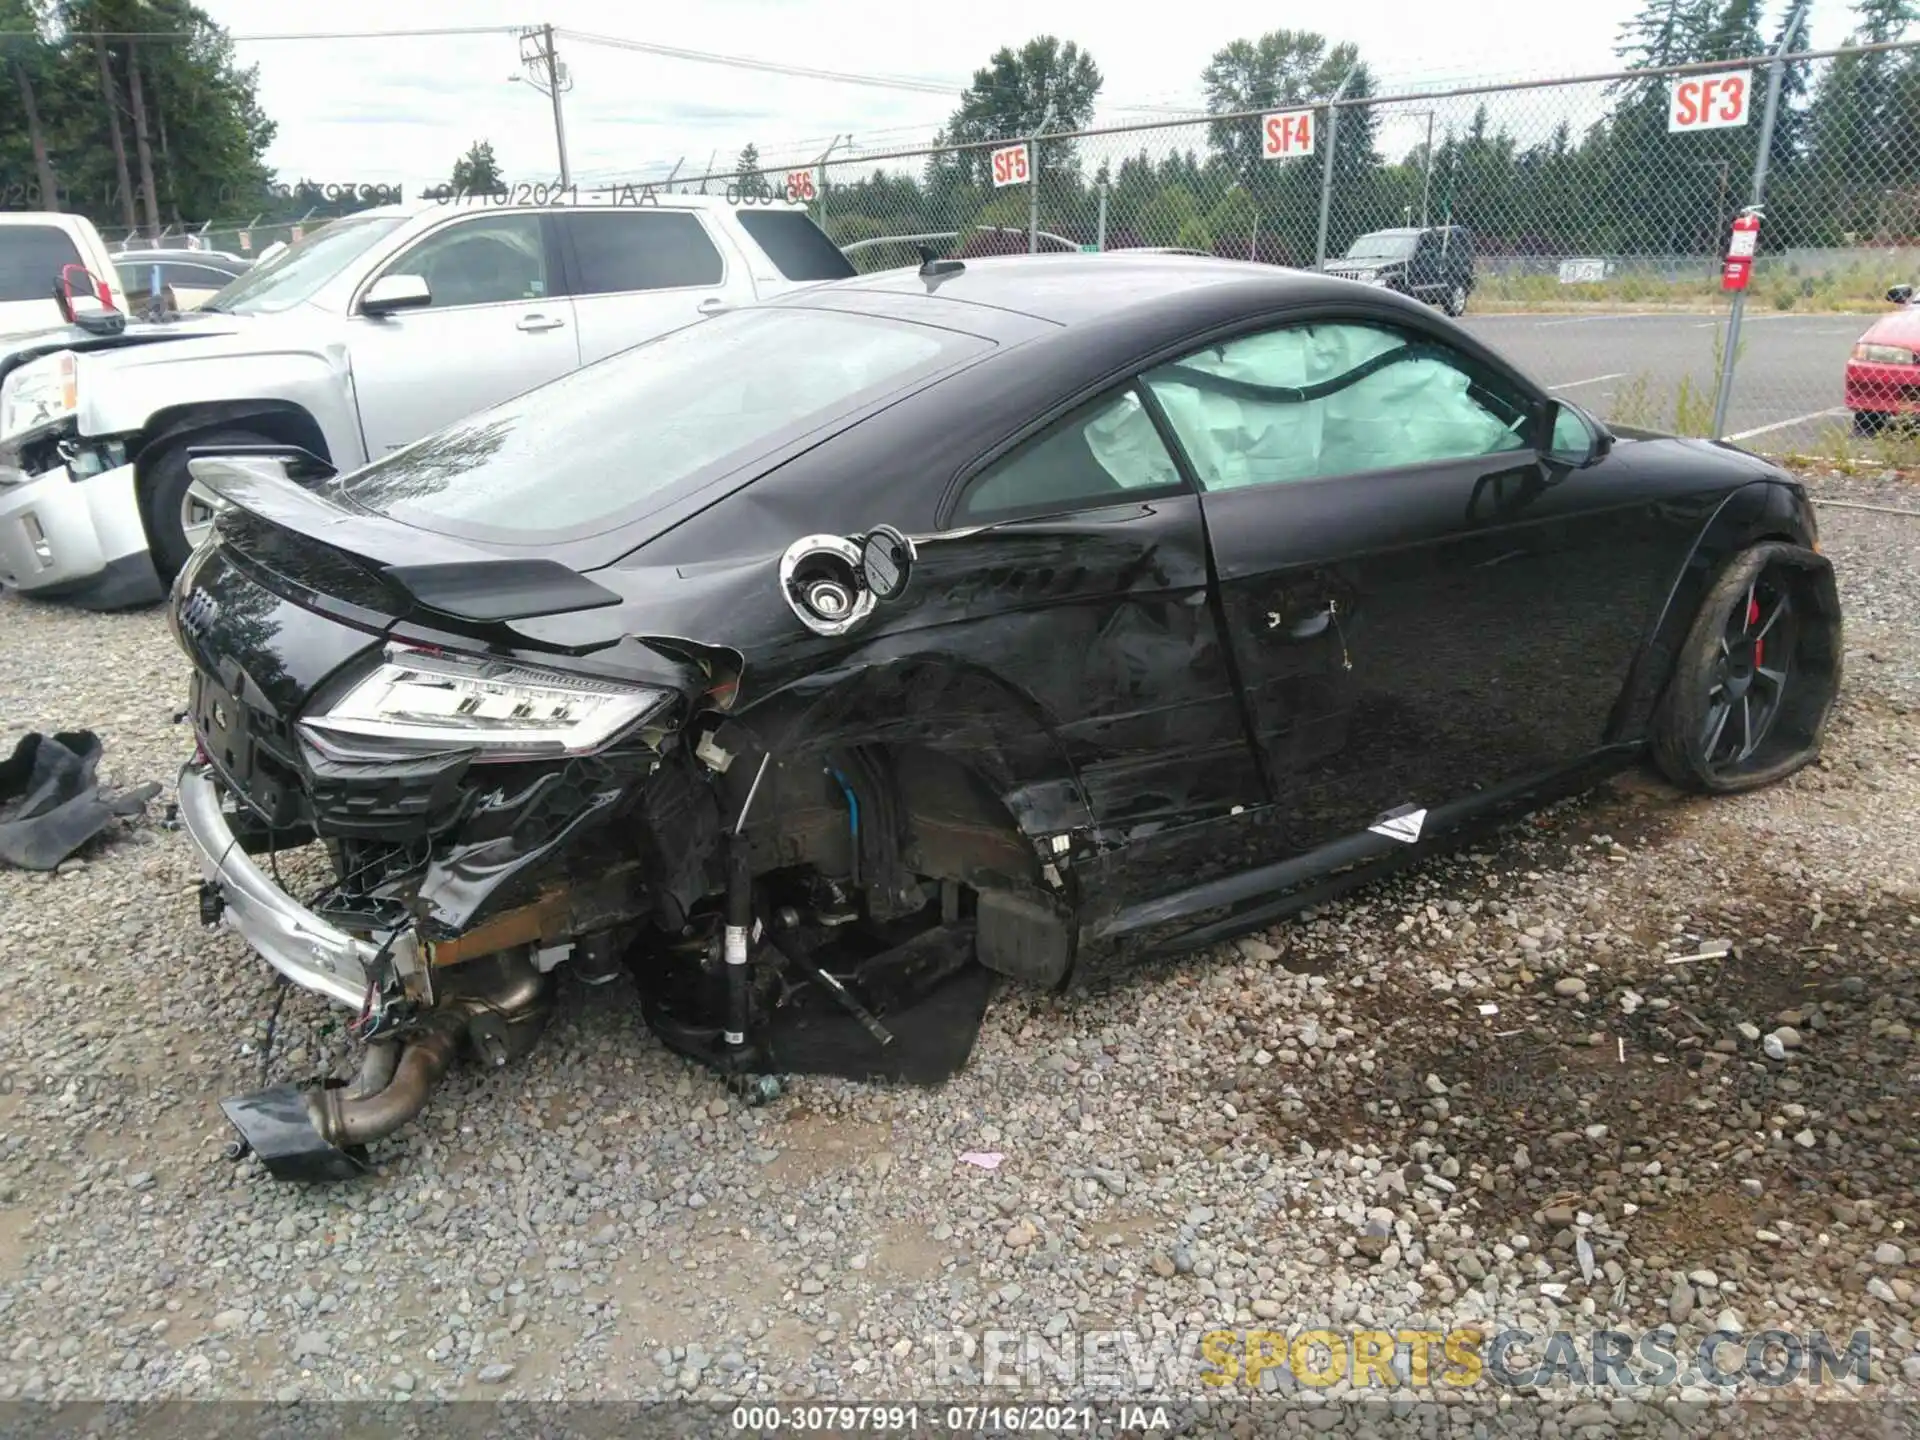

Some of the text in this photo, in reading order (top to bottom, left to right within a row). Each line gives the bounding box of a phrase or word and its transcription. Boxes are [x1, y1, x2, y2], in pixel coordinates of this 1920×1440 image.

[1676, 77, 1744, 125] SF3
[1267, 115, 1310, 153] SF4
[995, 148, 1025, 181] SF5
